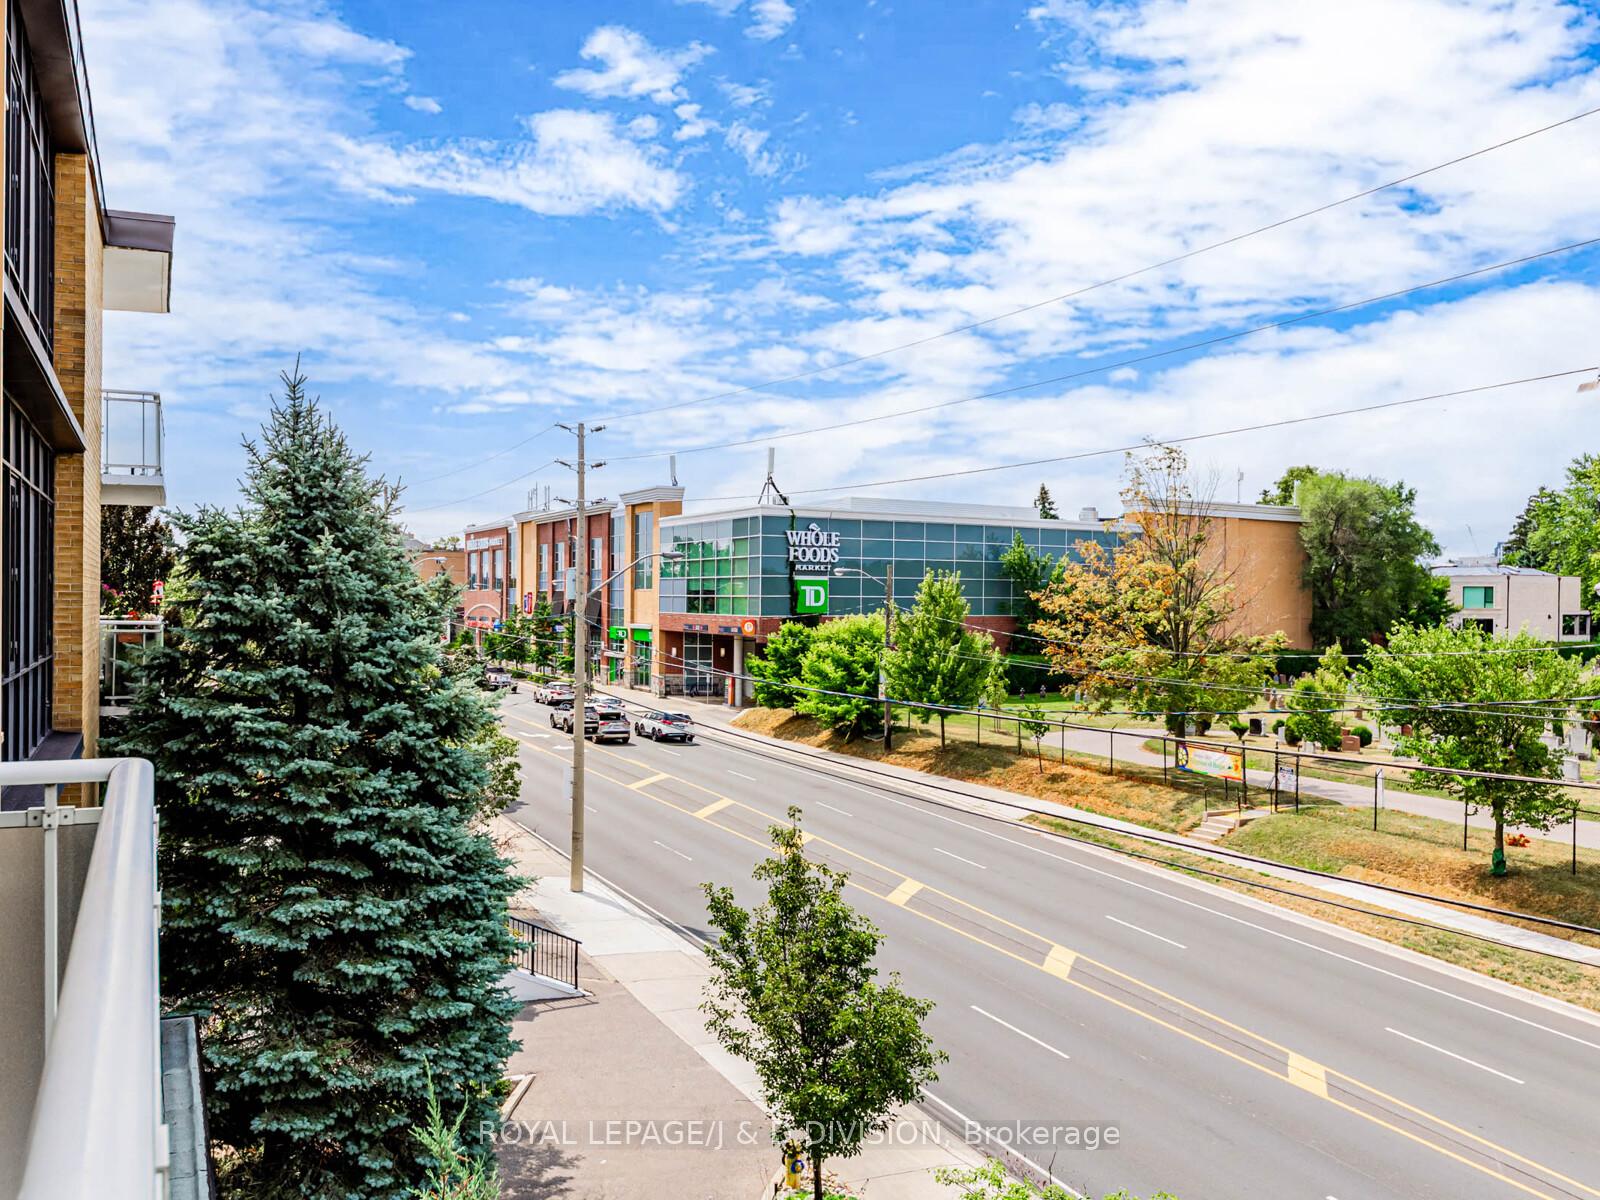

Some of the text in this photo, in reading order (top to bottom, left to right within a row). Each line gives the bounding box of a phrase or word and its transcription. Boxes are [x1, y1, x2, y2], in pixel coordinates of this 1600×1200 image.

[785, 529, 841, 547] WHOLE
[788, 546, 840, 563] FOODS
[800, 585, 826, 607] TD
